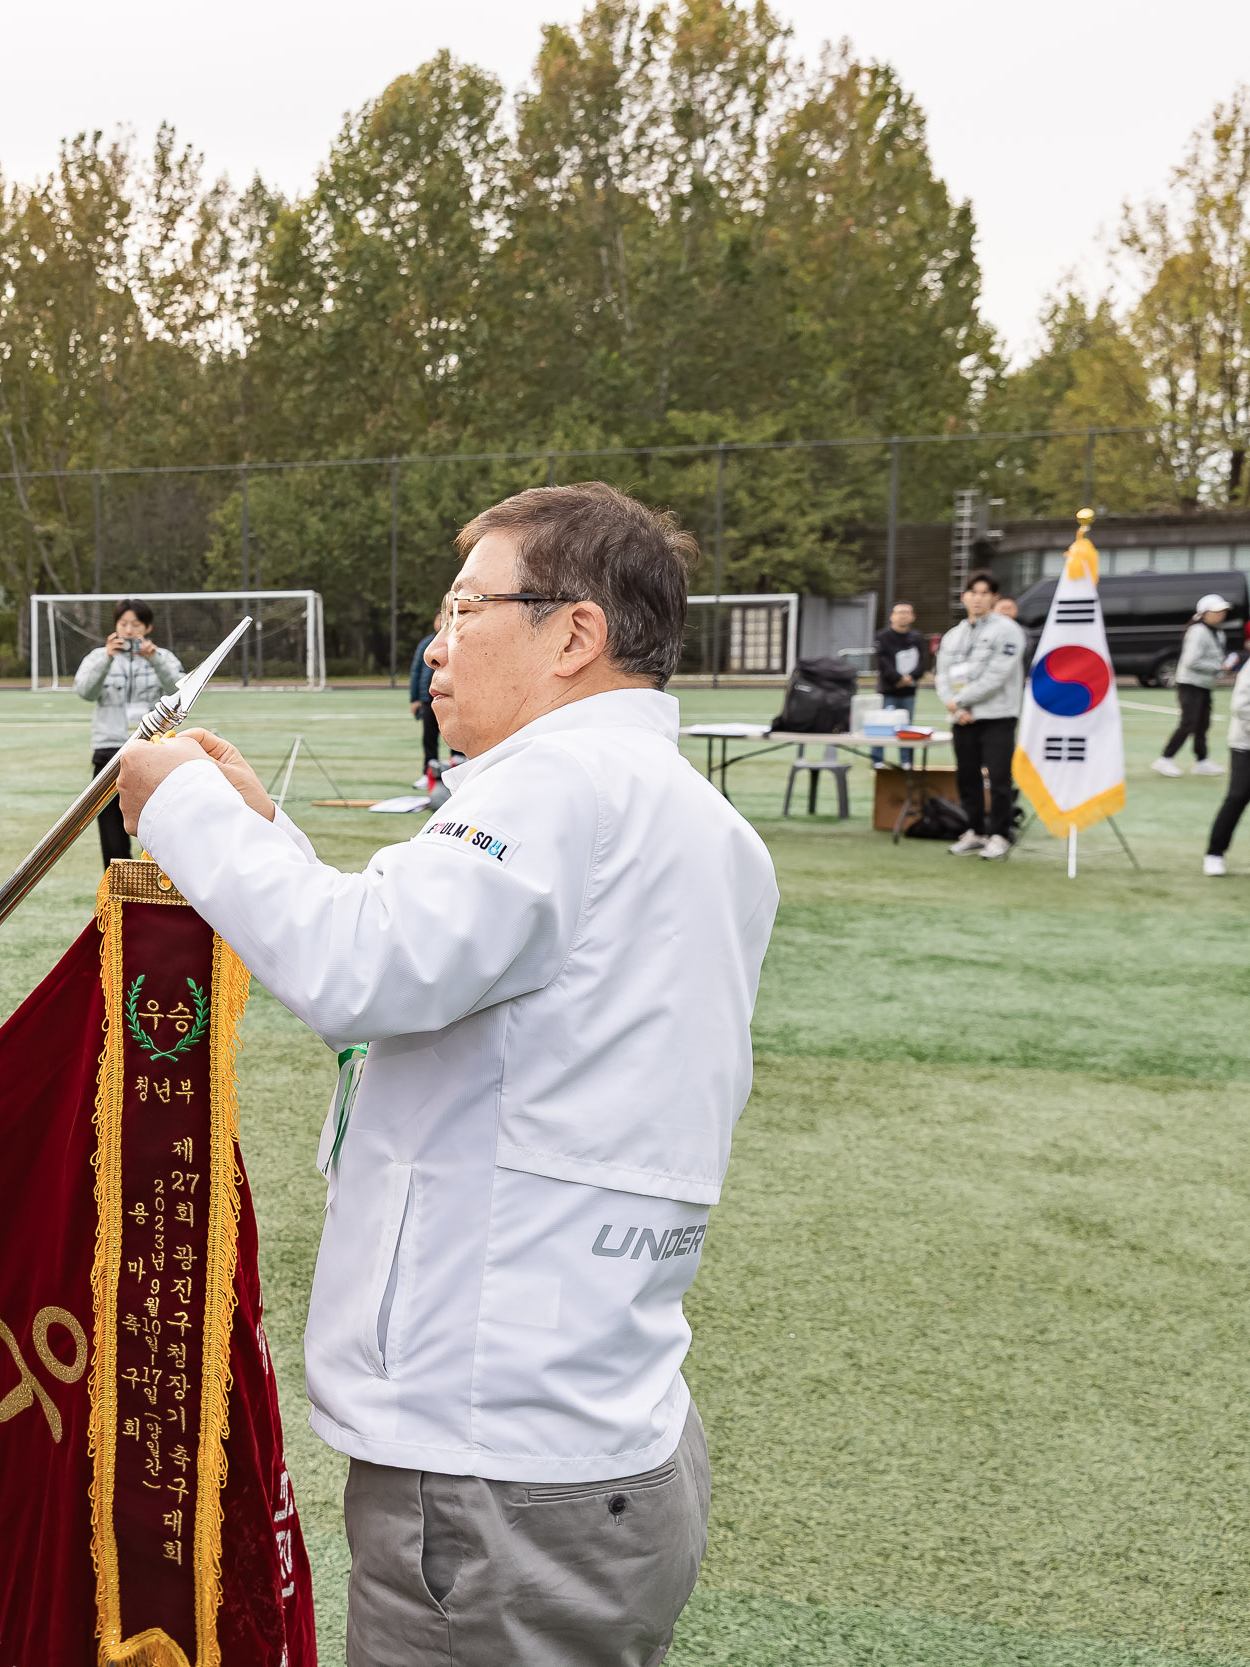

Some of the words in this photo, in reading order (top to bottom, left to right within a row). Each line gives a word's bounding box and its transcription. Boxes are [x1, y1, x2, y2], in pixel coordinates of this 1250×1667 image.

[137, 999, 194, 1032] 우승
[134, 1075, 195, 1104] 청년부
[591, 1224, 707, 1261] UNDER
[165, 1243, 198, 1434] 광진구청장기
[162, 1444, 191, 1566] 축구대회
